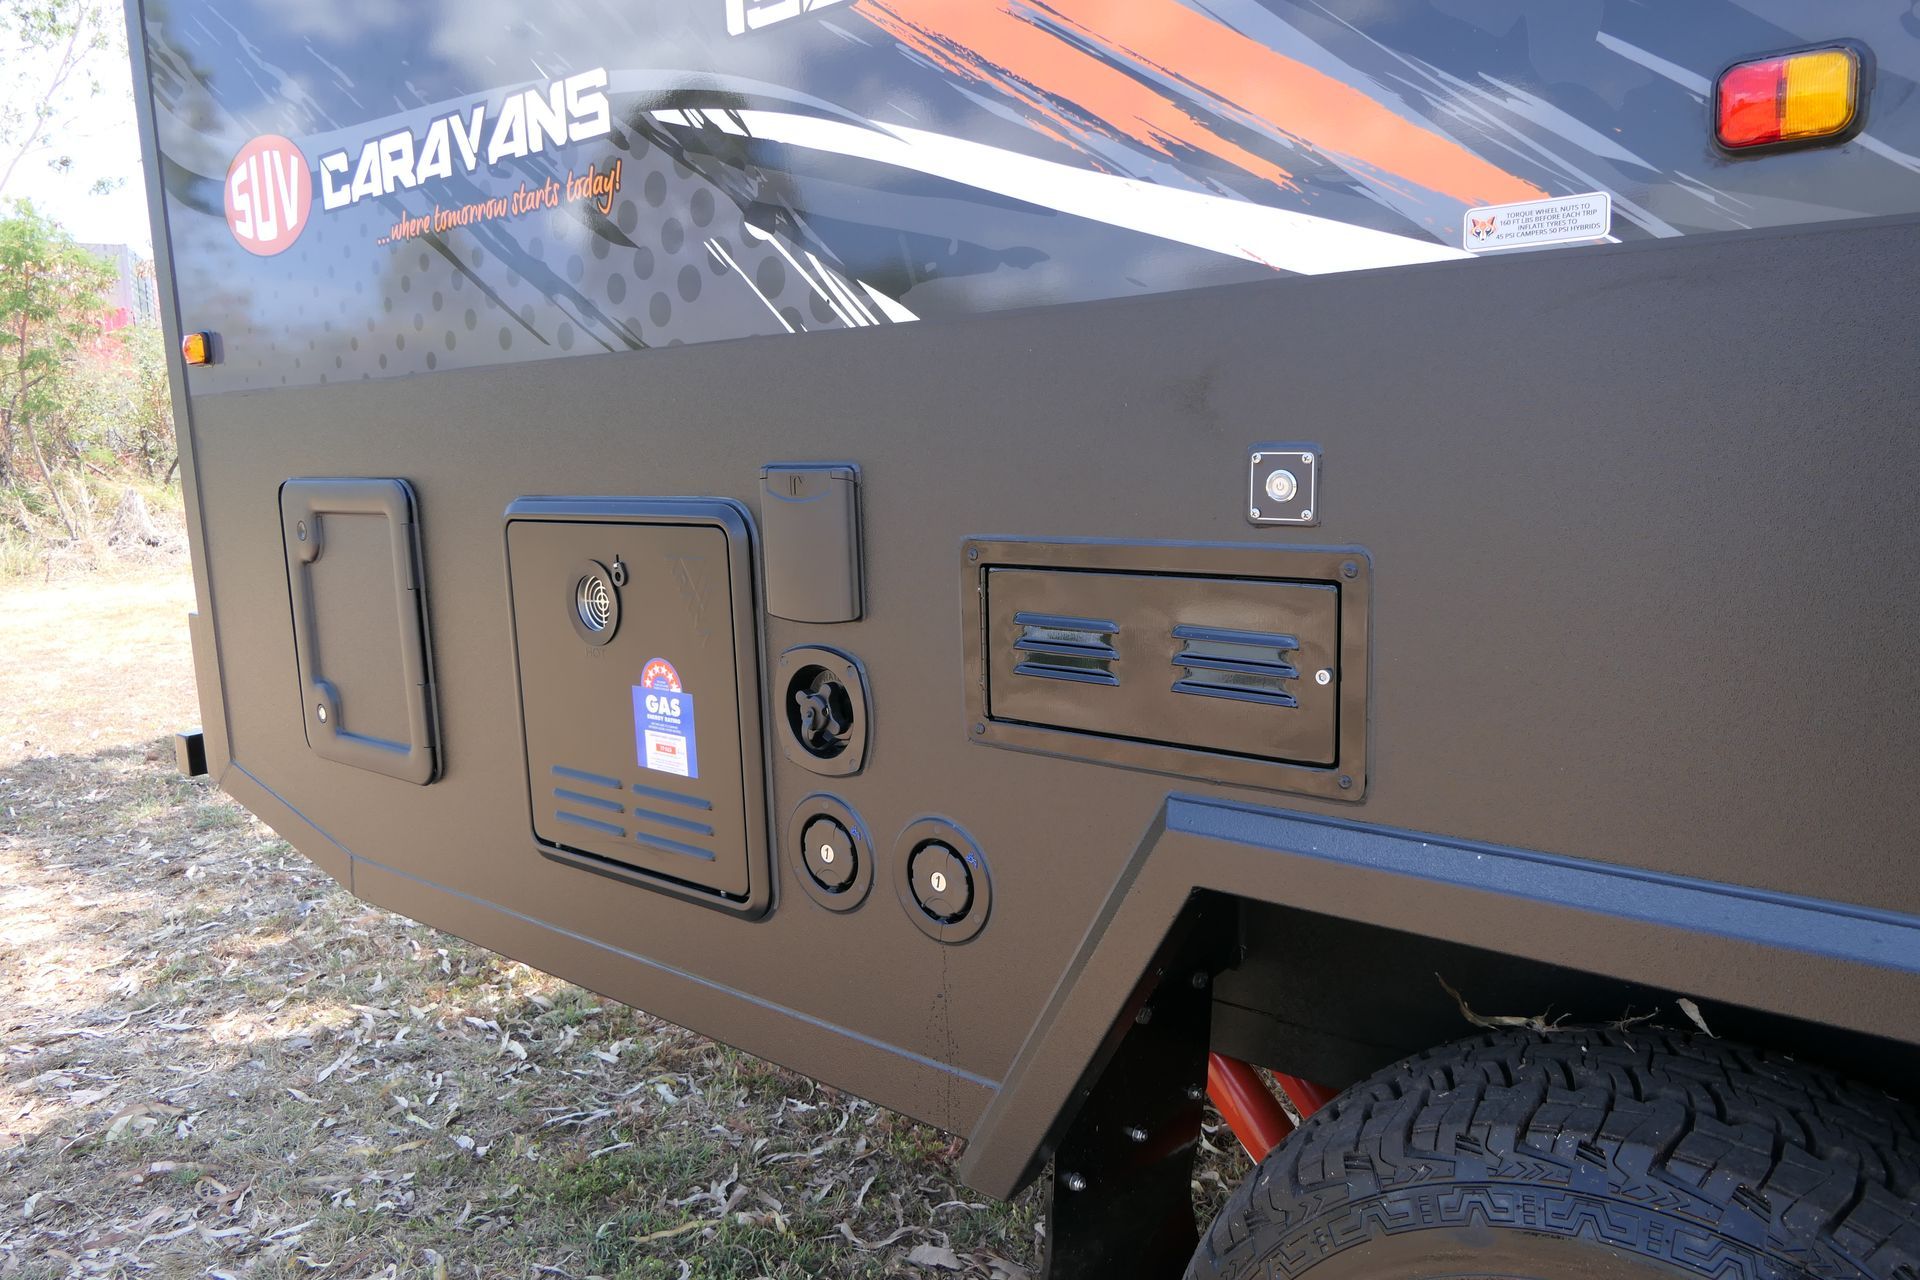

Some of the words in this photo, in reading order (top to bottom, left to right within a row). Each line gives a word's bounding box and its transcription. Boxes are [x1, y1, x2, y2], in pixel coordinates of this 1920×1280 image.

[319, 66, 612, 211] CARAVANS
[231, 149, 299, 241] SUV
[433, 198, 507, 233] tomorrow
[511, 181, 560, 217] starts
[566, 159, 622, 215] today!
[1506, 210, 1534, 218] TORQUE
[1535, 208, 1559, 216] WHEEL
[1534, 214, 1561, 222] BEFORE
[1517, 223, 1545, 231] INFLATE
[1545, 221, 1567, 229] TYRES
[1517, 229, 1548, 237] CAMPERS
[1570, 223, 1601, 232] HYBRIDS
[645, 694, 681, 717] GAS
